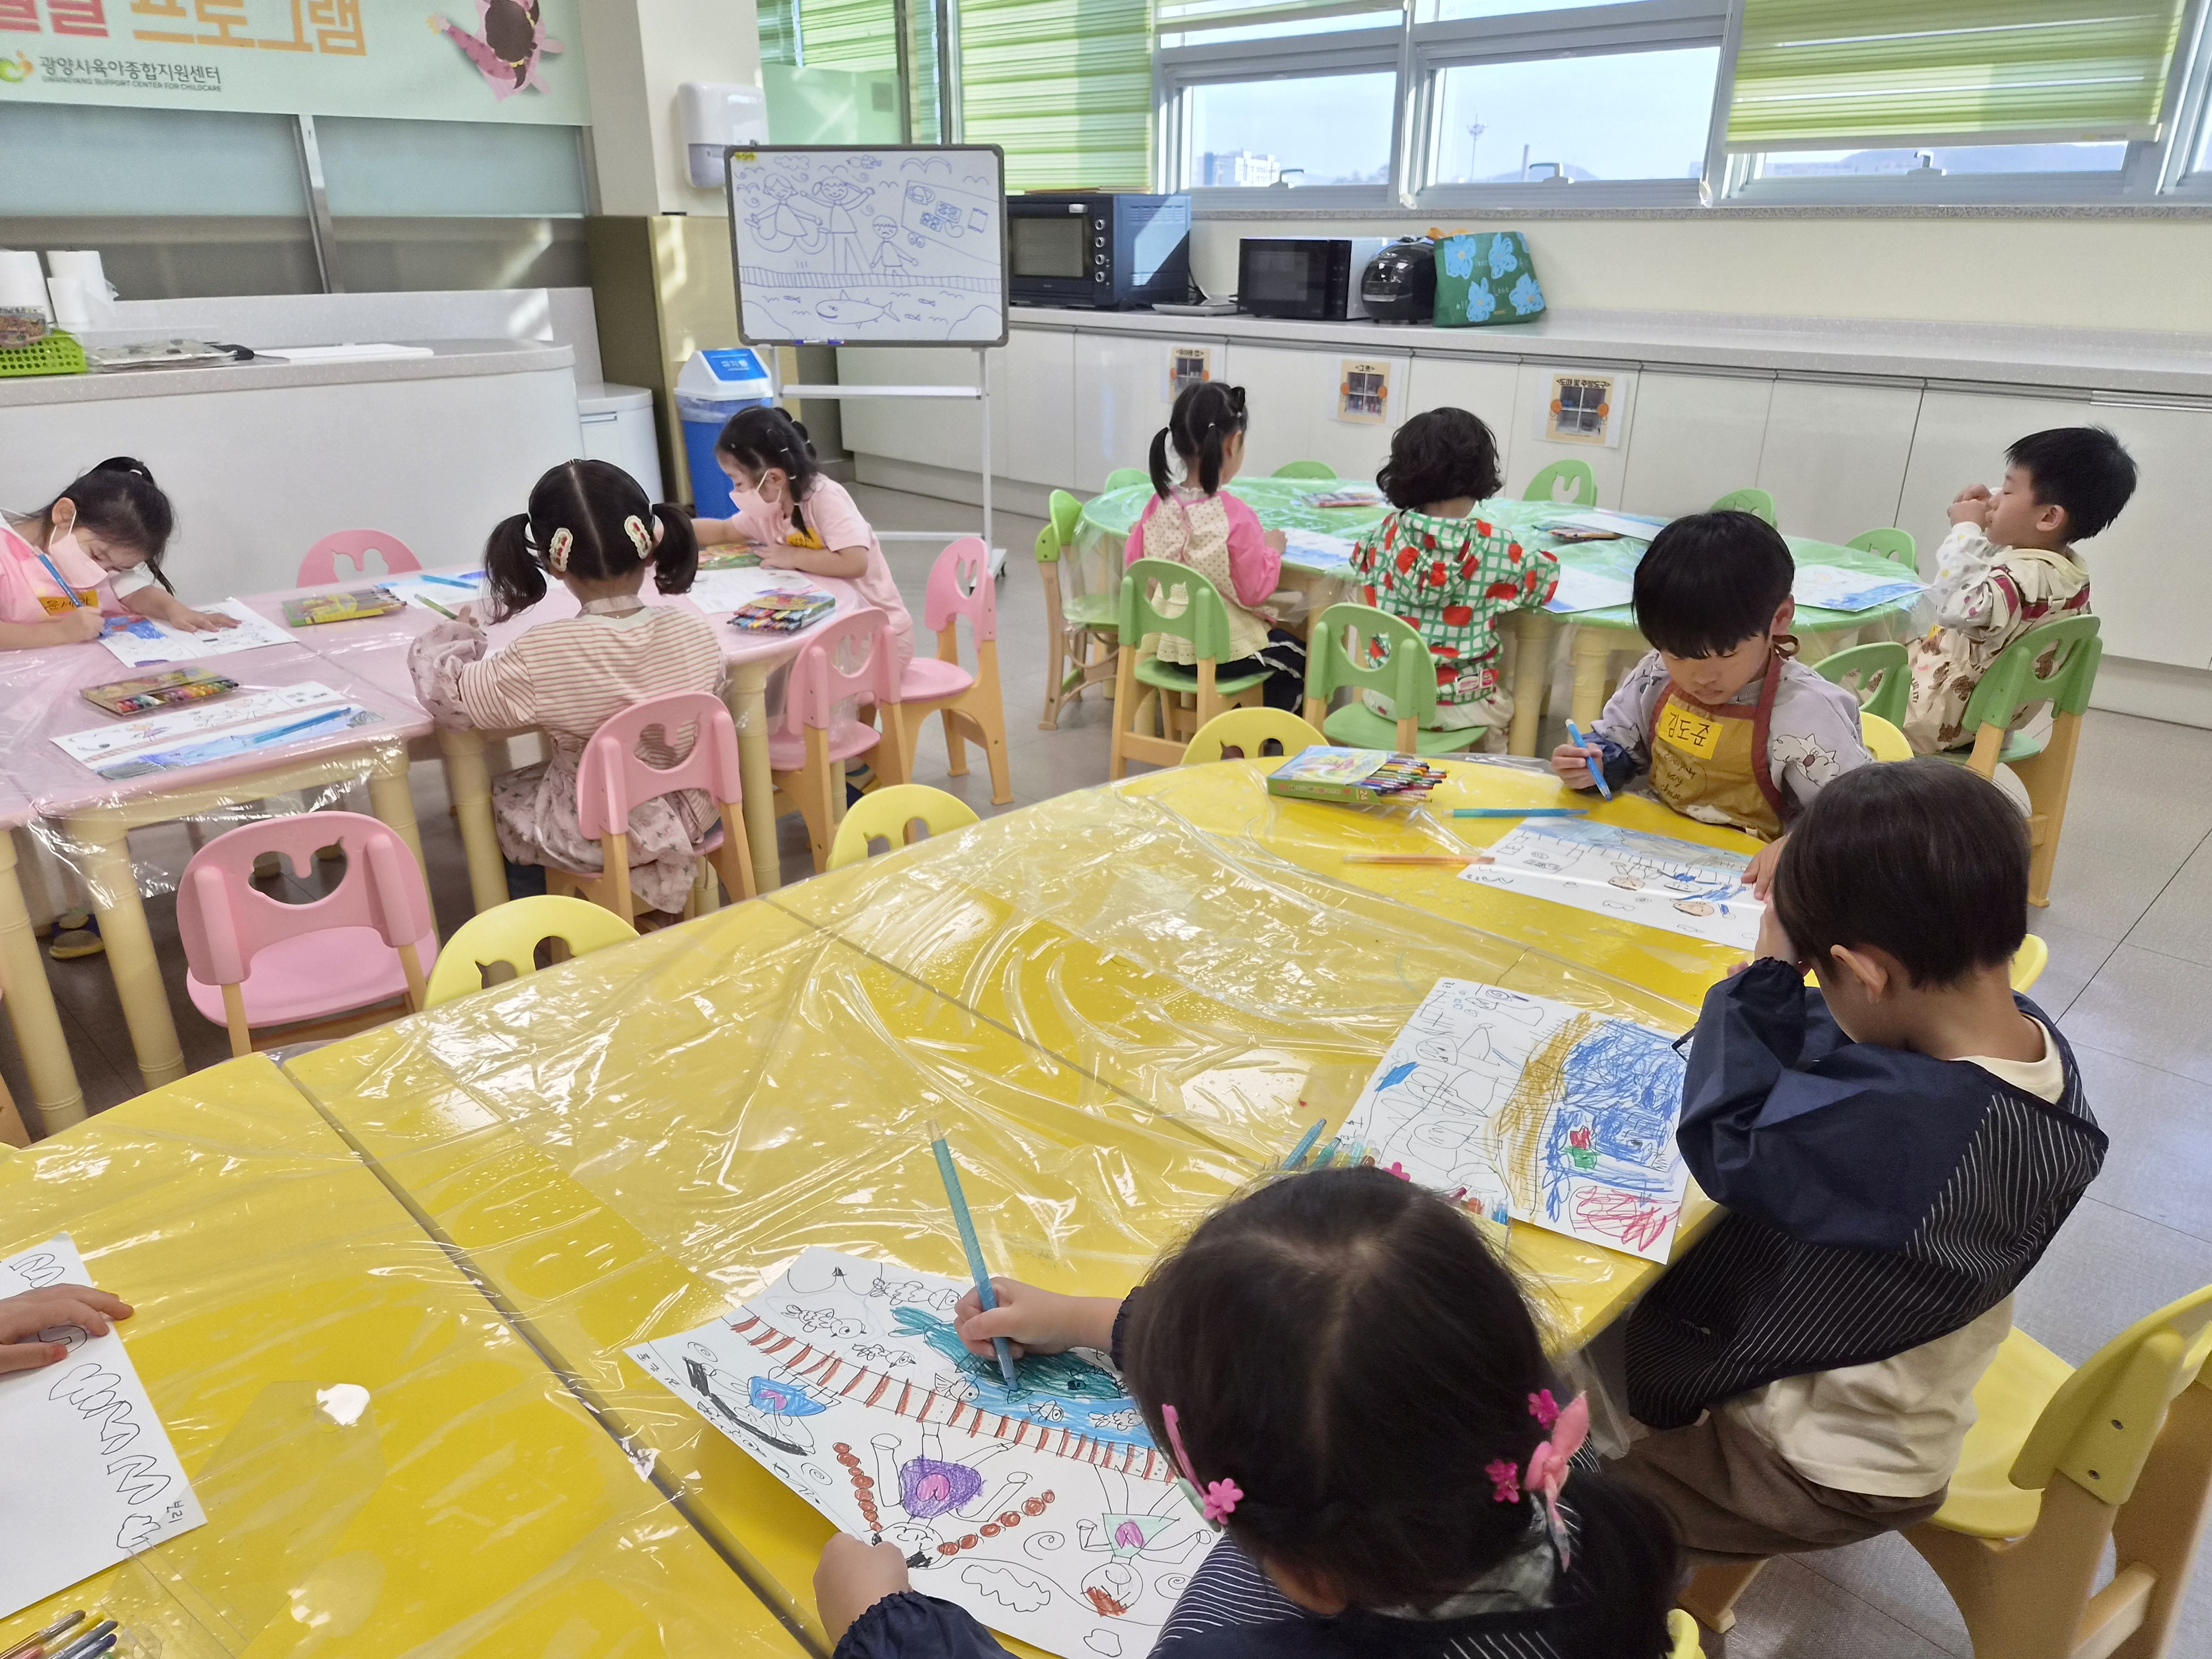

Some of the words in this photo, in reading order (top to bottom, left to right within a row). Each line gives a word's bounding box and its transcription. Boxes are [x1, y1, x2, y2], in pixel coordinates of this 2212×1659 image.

[39, 56, 221, 84] 광양시육아종합지원센터
[1668, 712, 1710, 747] 김도준
[1359, 789, 1368, 801] 24
